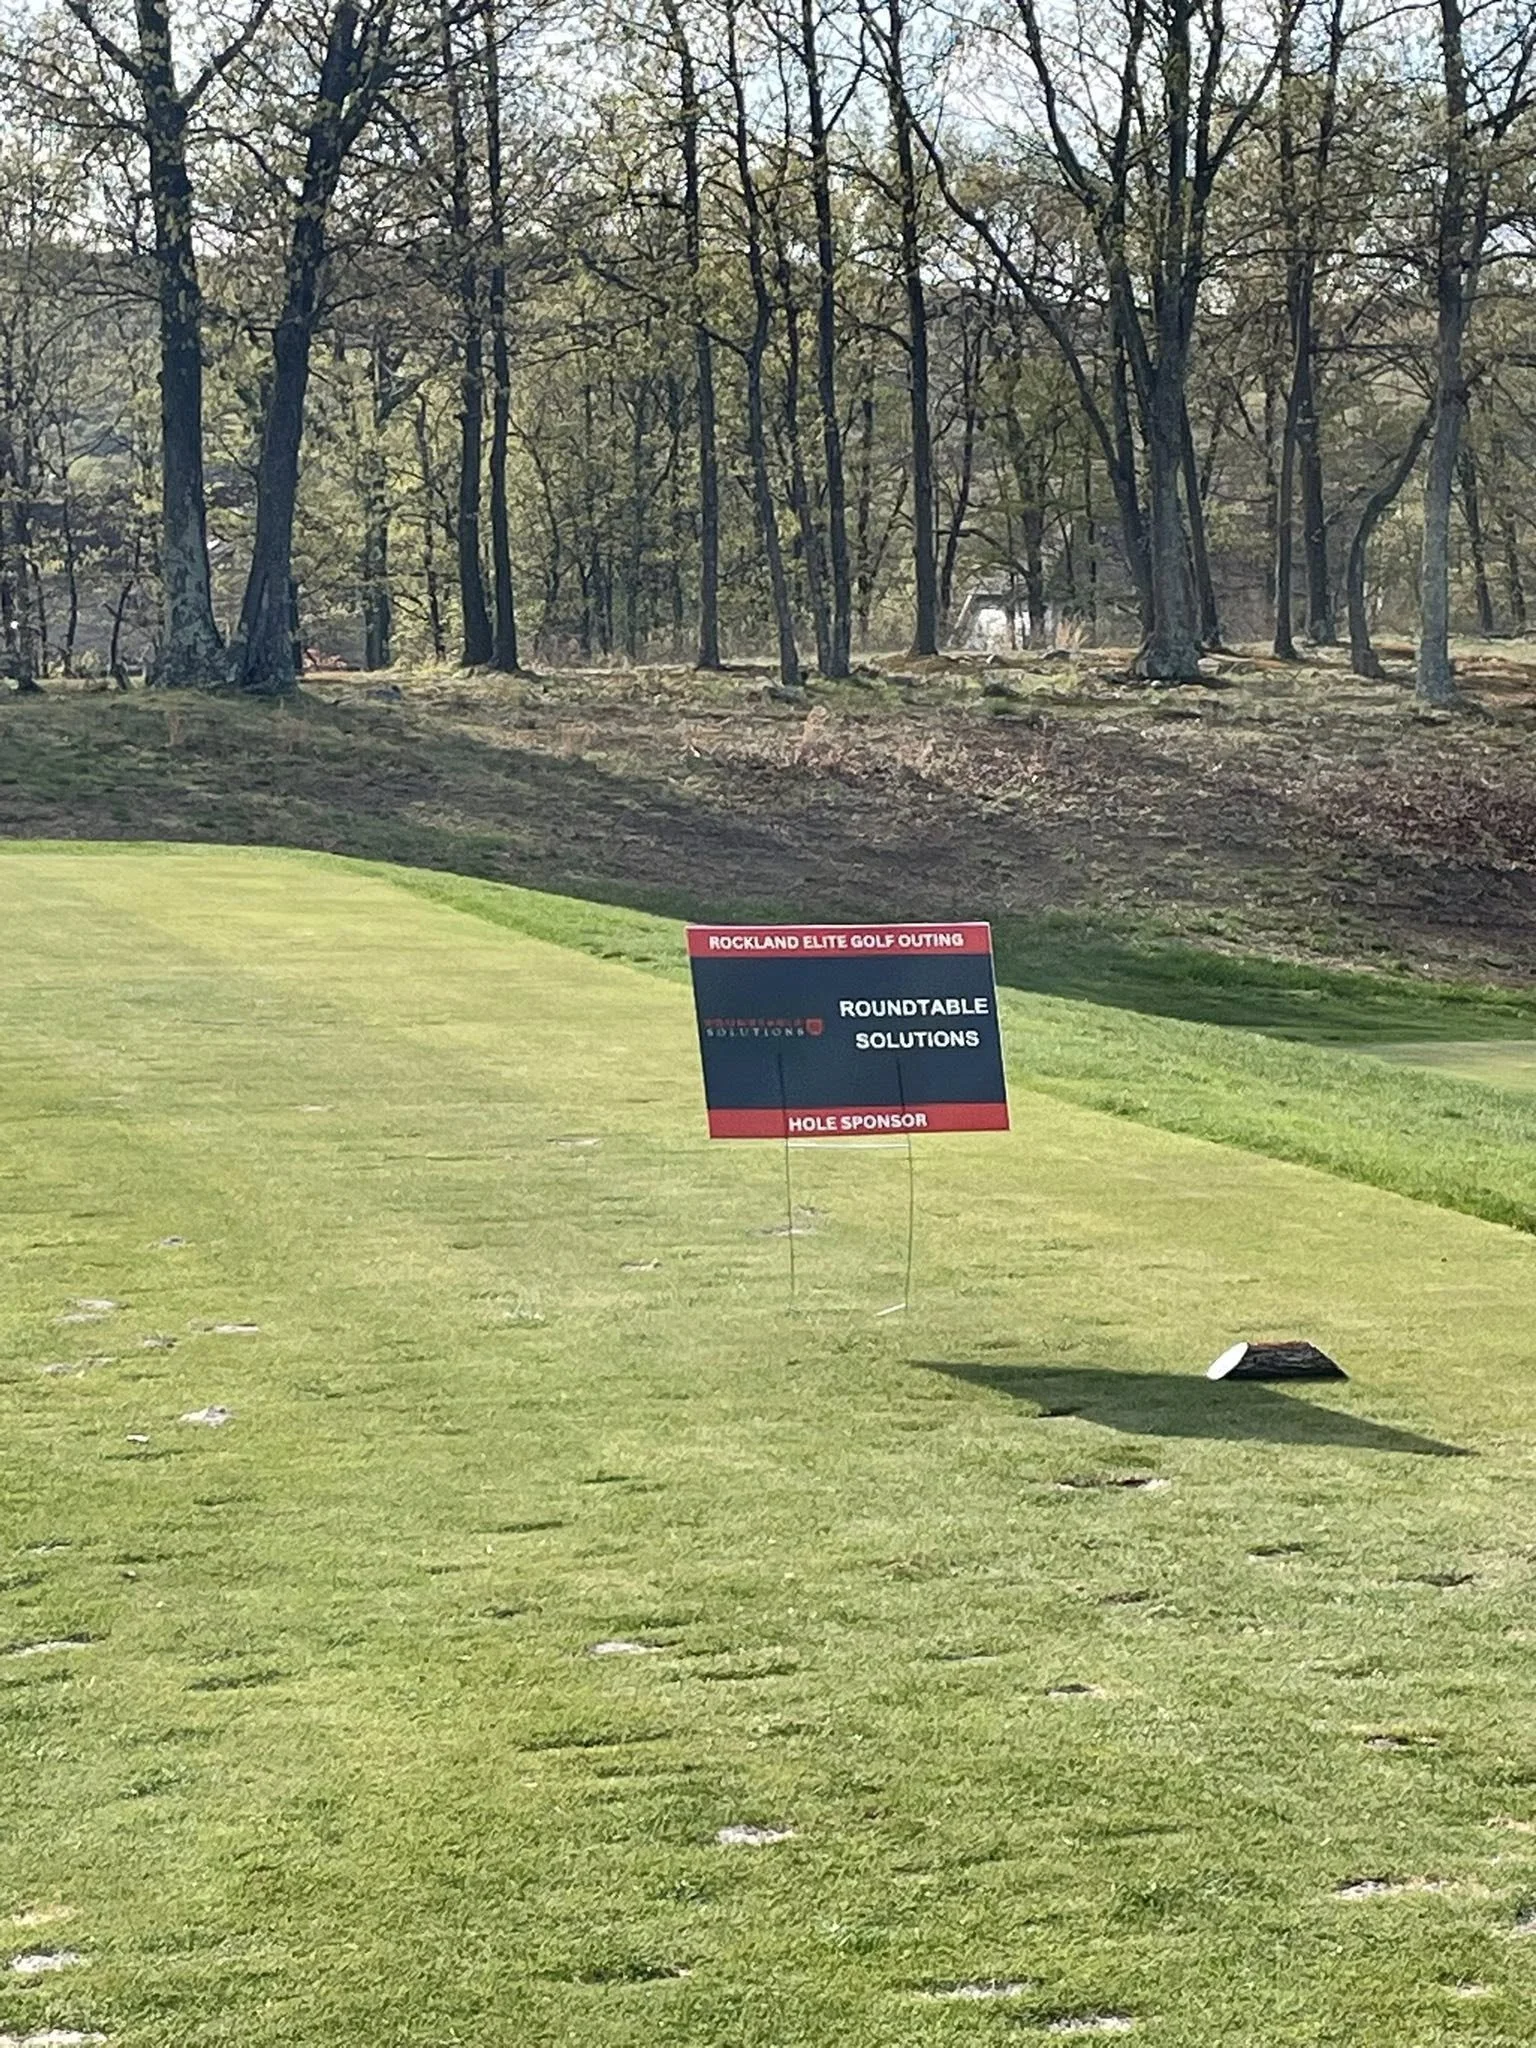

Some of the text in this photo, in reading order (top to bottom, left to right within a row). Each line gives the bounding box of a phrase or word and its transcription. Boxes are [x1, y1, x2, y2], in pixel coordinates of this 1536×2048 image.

[709, 933, 964, 950] ROCKLAND ELITE GOLF OUTING
[839, 998, 989, 1017] ROUNDTABLE
[855, 1030, 980, 1049] SOLUTIONS
[788, 1113, 928, 1132] HOLE SPONSOR
